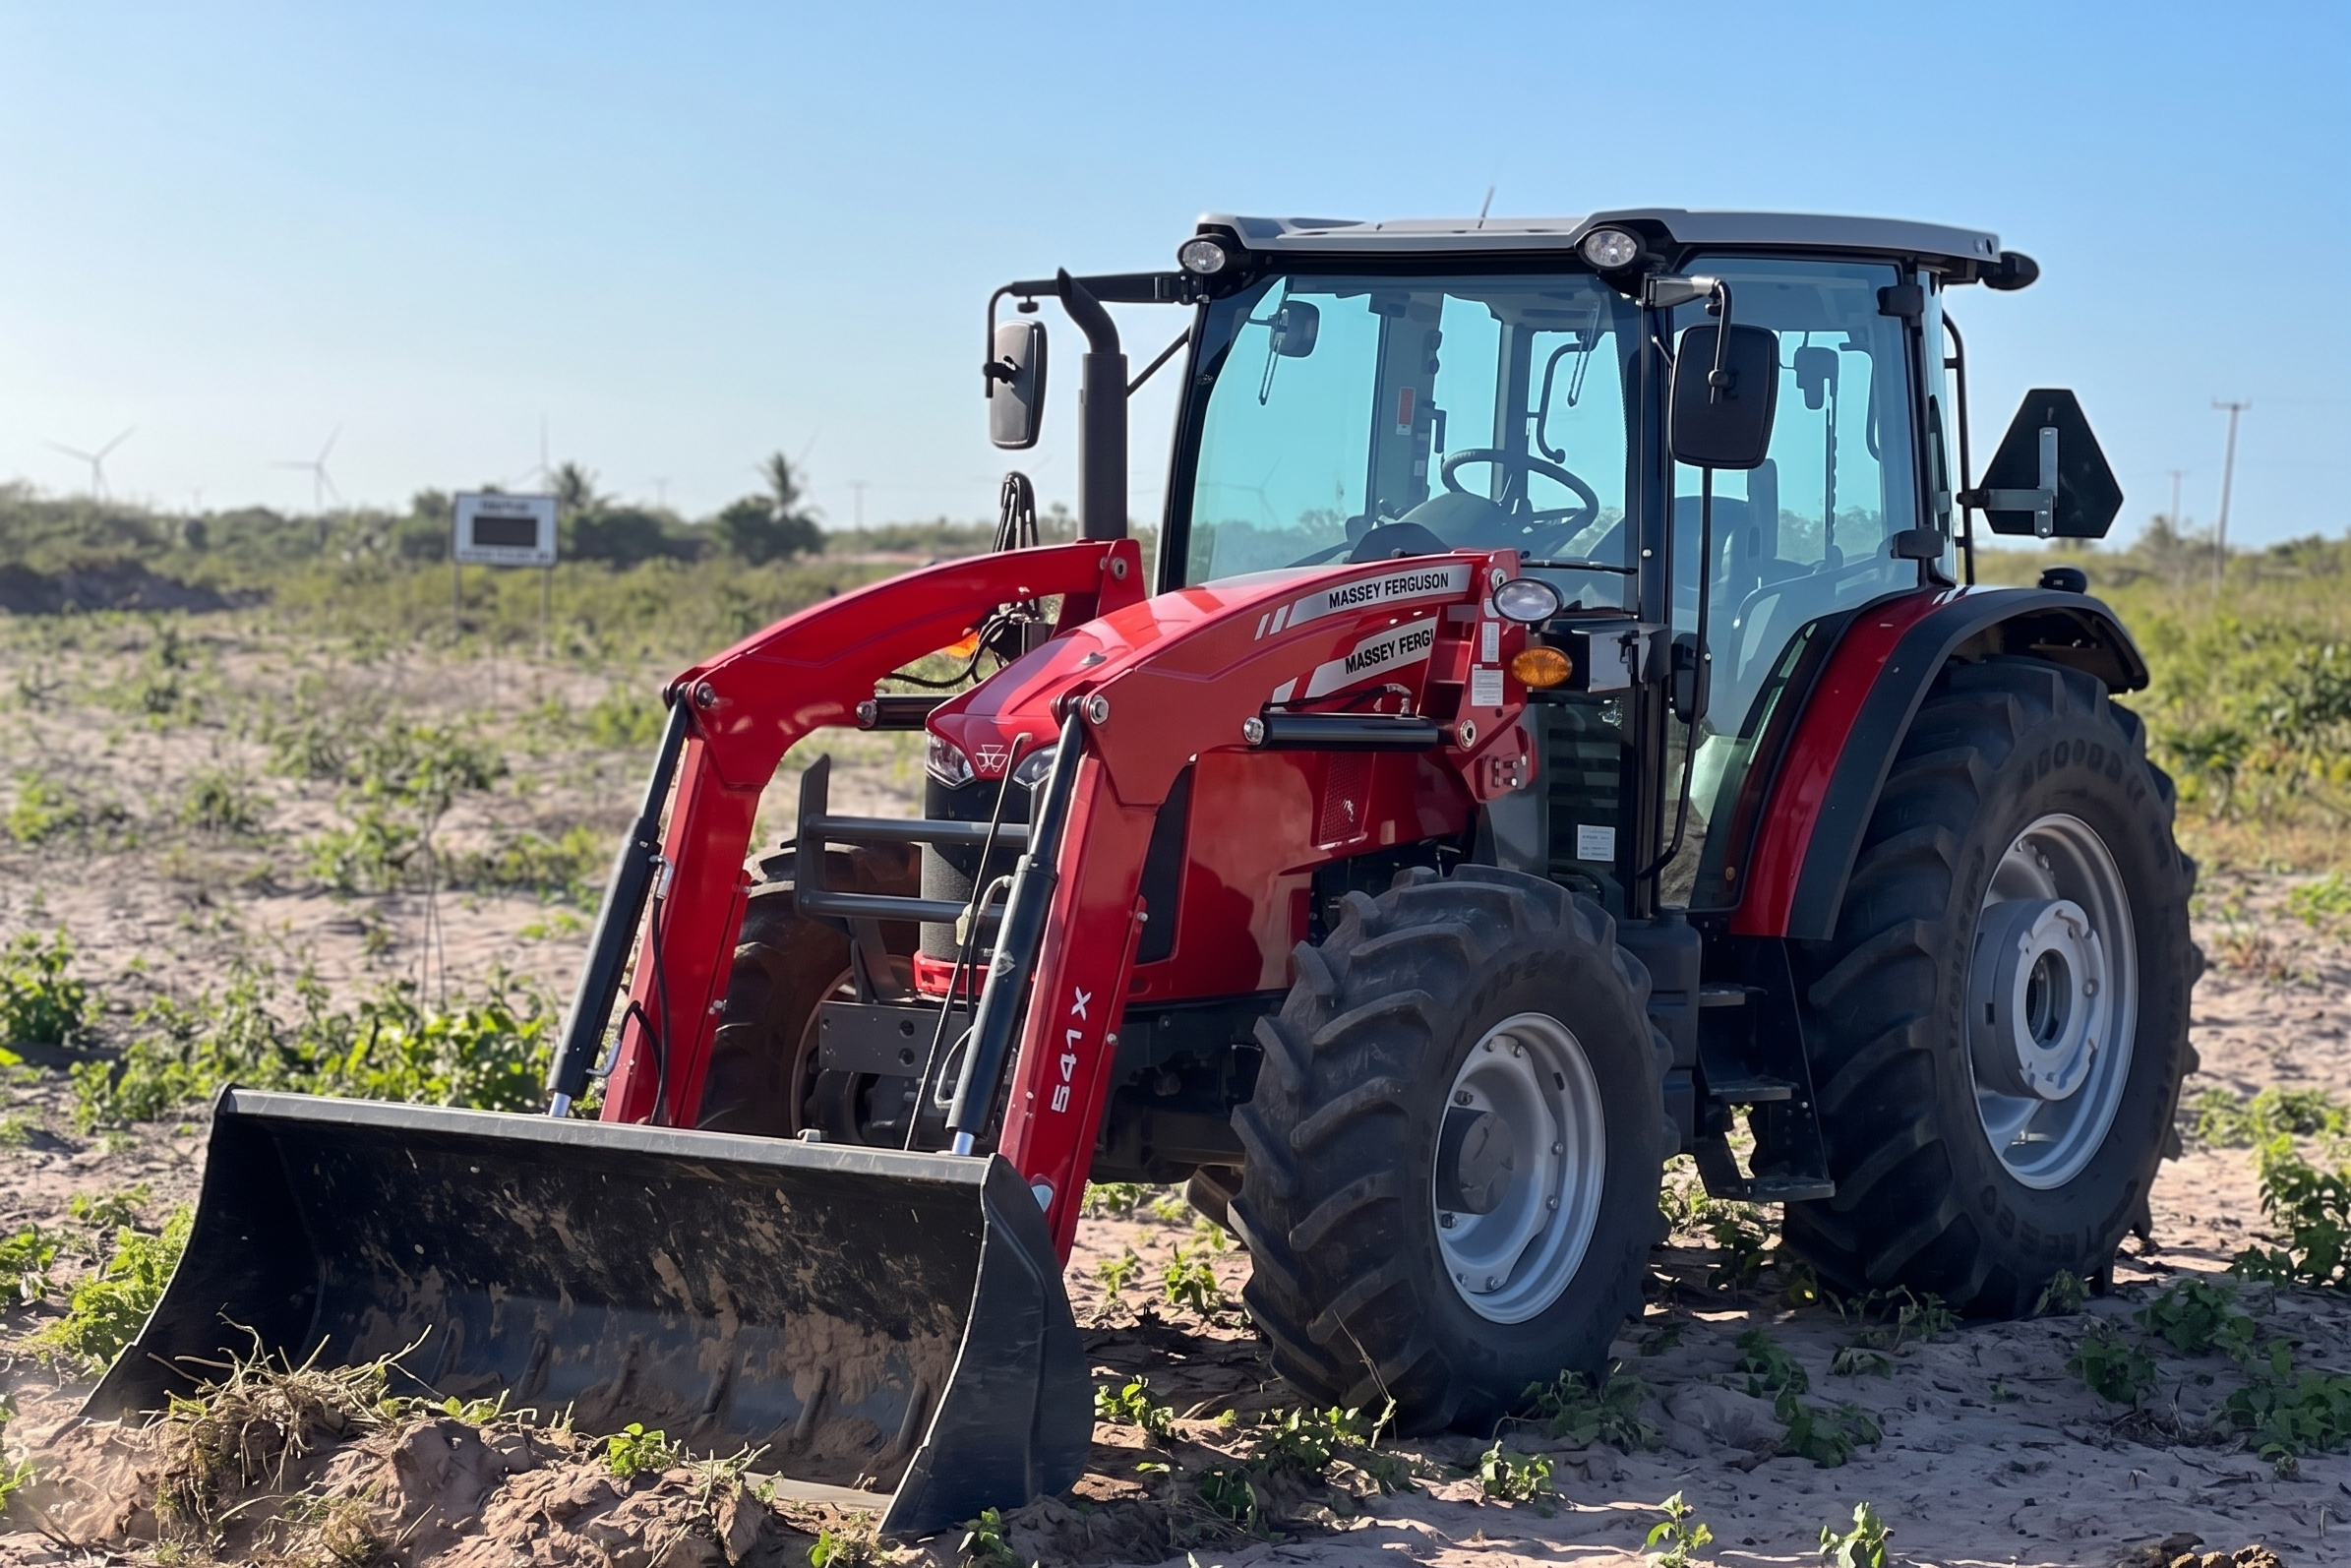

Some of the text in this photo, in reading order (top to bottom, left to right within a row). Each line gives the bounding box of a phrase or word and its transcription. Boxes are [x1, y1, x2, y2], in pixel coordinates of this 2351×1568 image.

[1329, 573, 1449, 609] MASSEY FERGUSON
[1345, 640, 1396, 675] MASSEY
